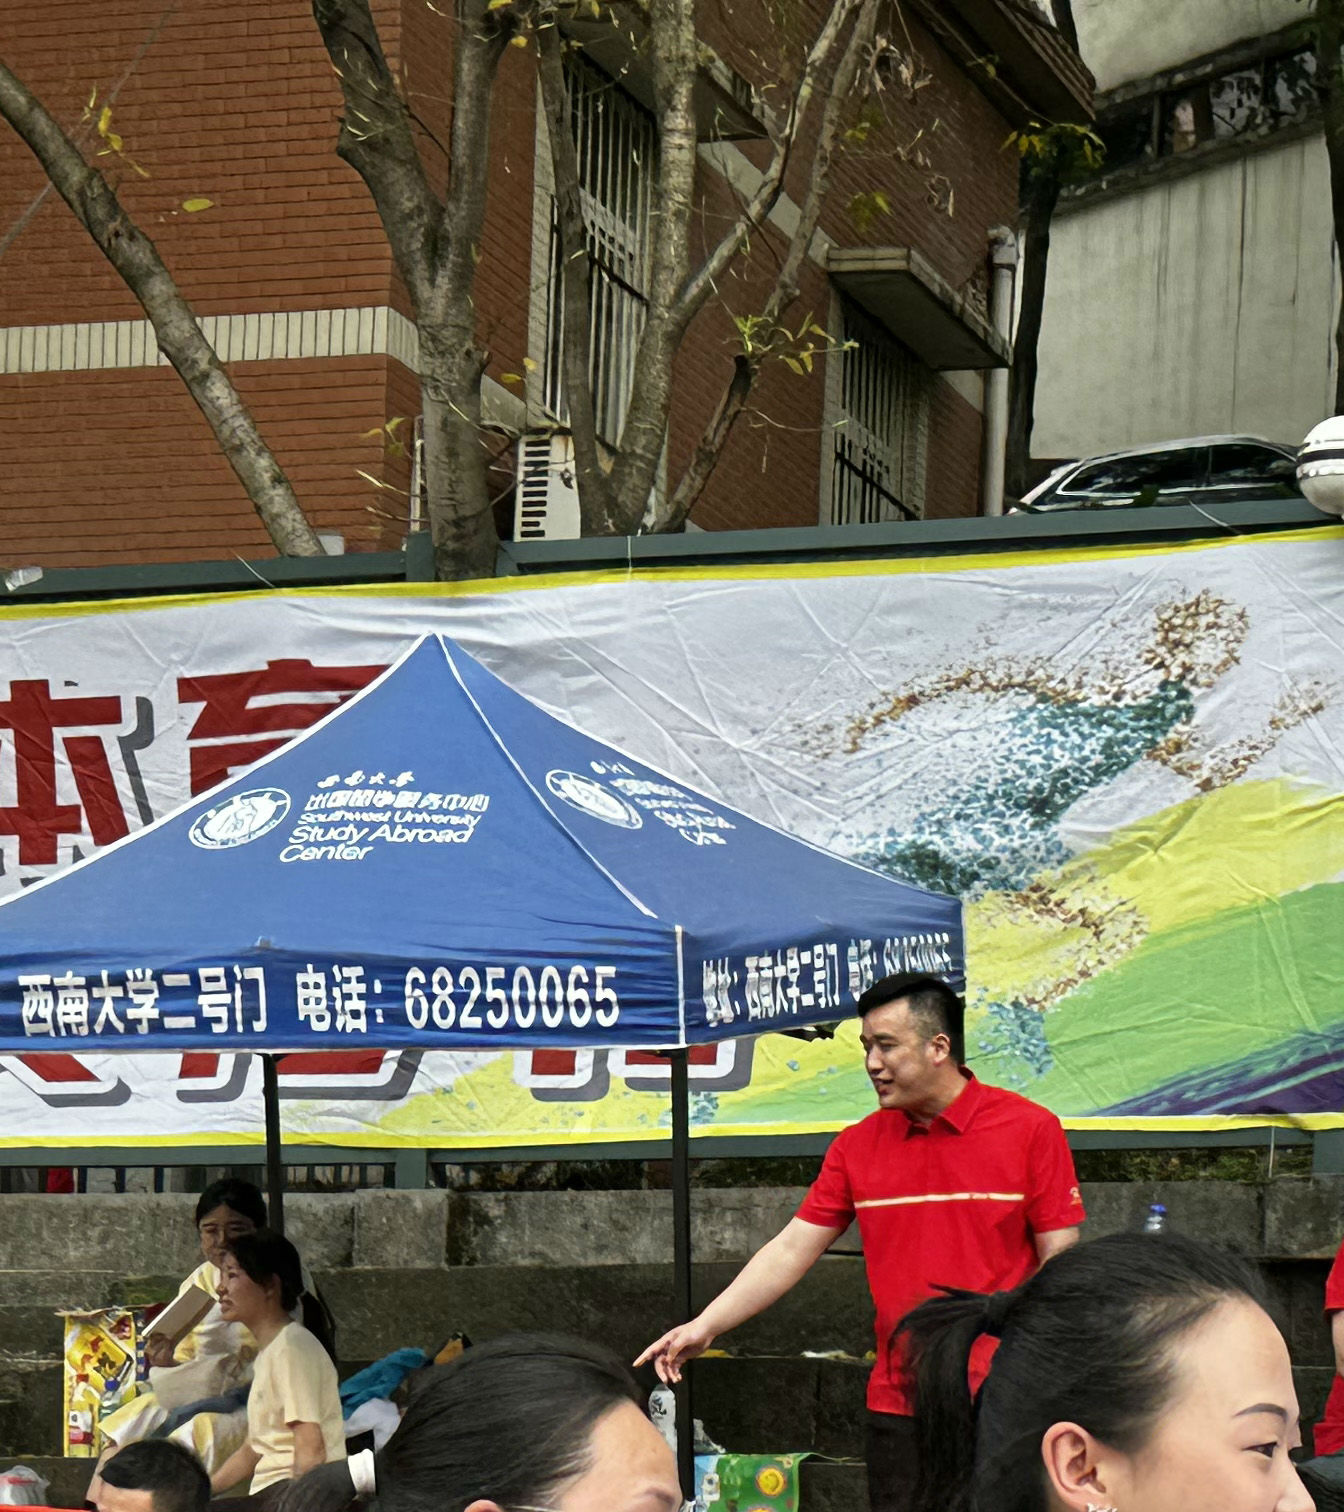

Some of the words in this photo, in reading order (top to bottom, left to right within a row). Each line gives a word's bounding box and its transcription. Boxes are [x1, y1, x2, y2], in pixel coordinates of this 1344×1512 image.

[297, 809, 392, 825] Southwest
[394, 811, 482, 827] University
[288, 823, 370, 845] Study
[367, 823, 476, 844] Abroad
[279, 844, 374, 863] Center
